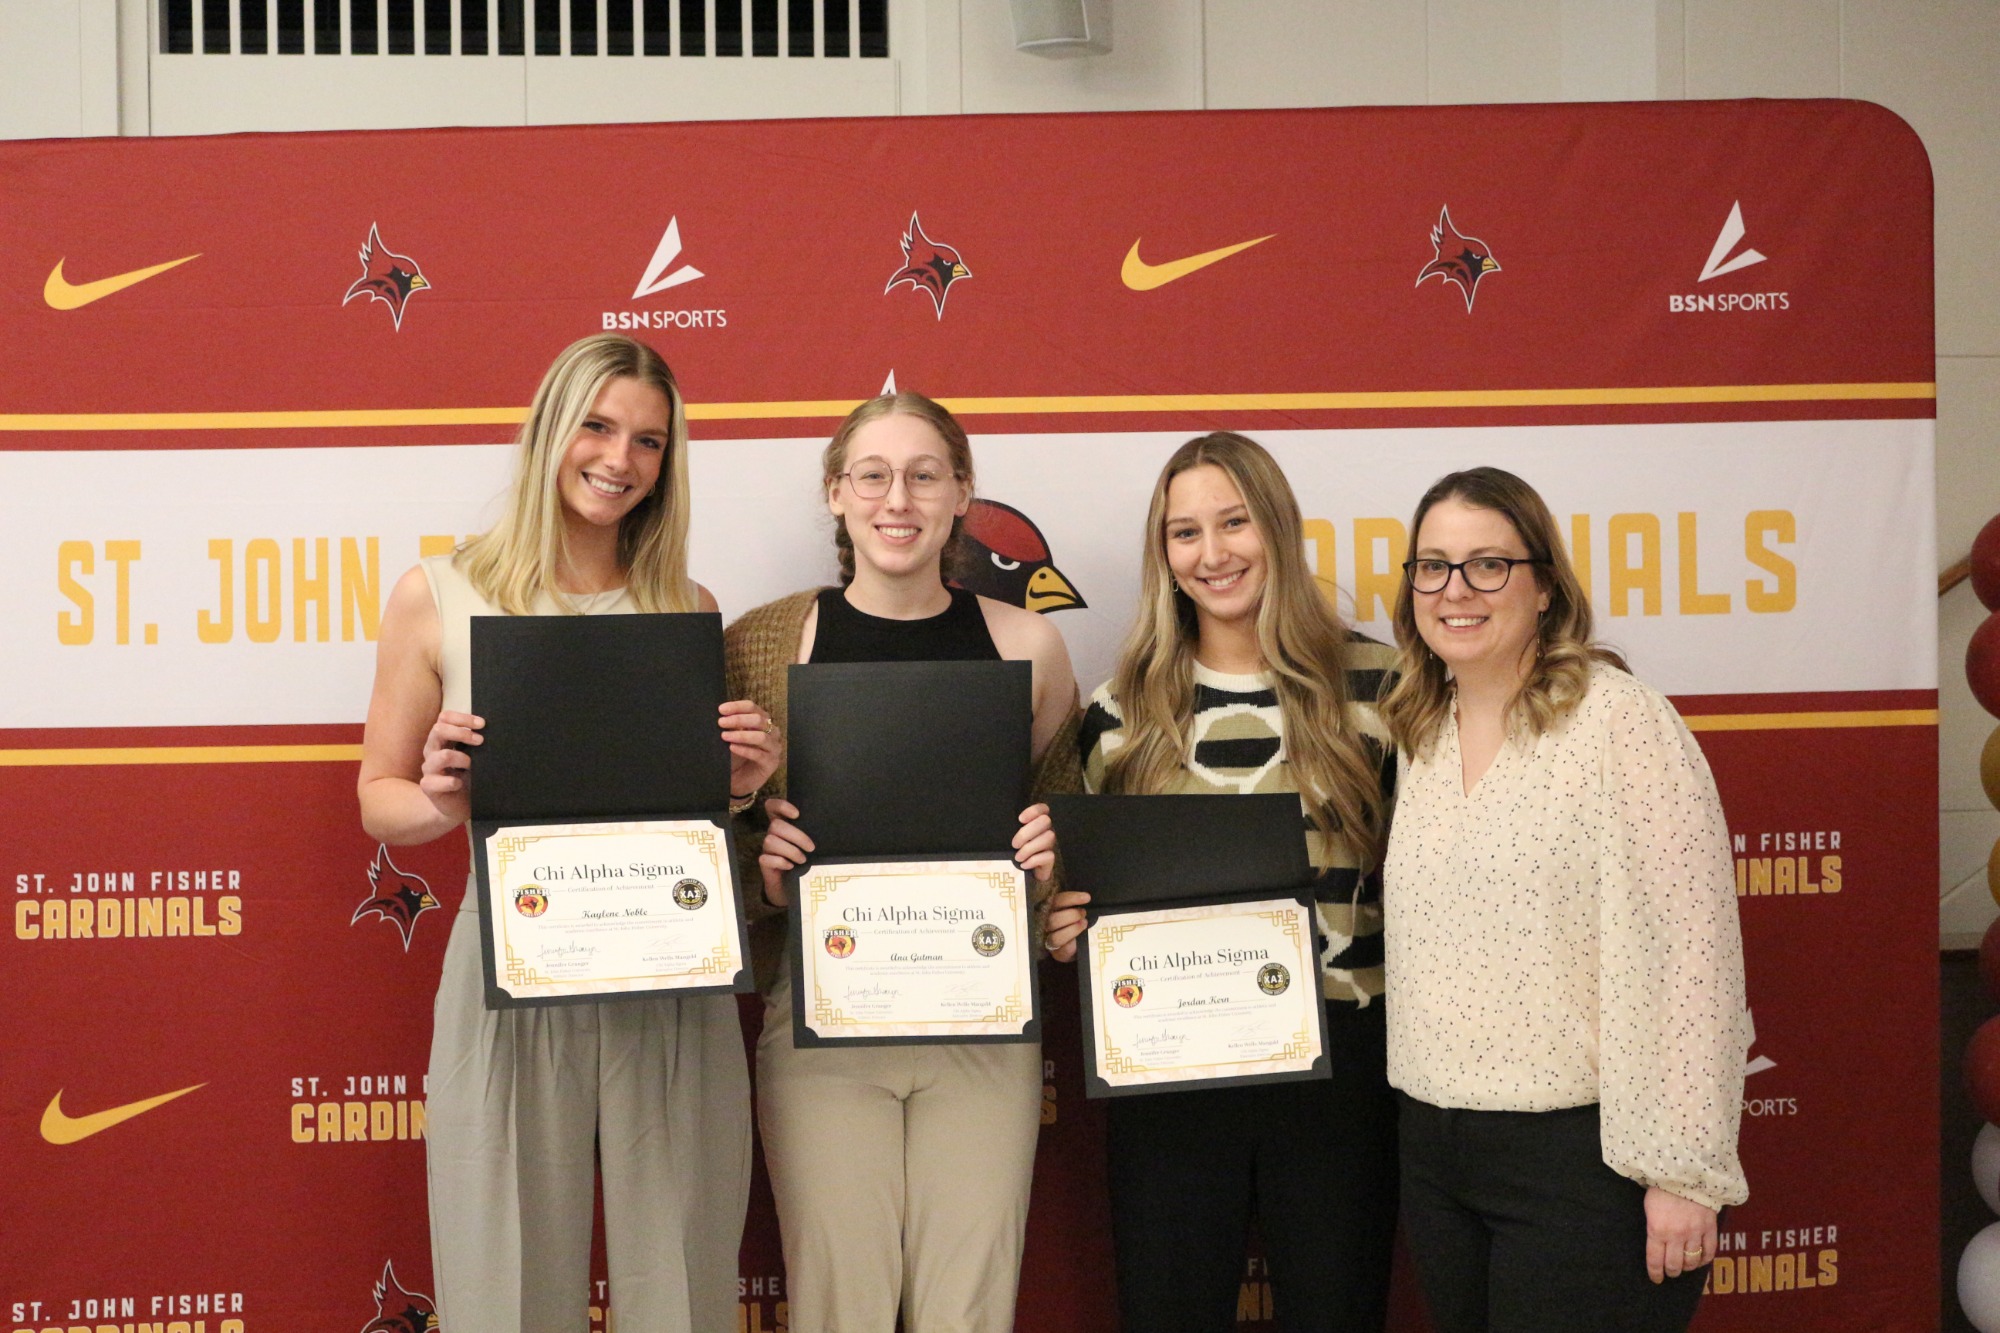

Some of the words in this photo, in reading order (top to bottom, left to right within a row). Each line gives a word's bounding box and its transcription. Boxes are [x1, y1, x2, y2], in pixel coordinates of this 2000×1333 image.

[1669, 294, 1715, 312] BSN
[1718, 292, 1790, 312] SPORTS
[602, 311, 650, 330] BSN
[652, 309, 727, 329] SPORTS
[56, 539, 158, 646] ST.
[197, 536, 380, 644] JOHN
[1760, 831, 1841, 852] FISHER
[16, 874, 54, 893] ST.
[70, 872, 135, 893] JOHN
[150, 870, 241, 891] FISHER
[533, 865, 565, 881] Chi
[570, 863, 624, 882] Alpha
[629, 862, 685, 881] Sigma
[1736, 855, 1842, 896] INALS
[15, 896, 242, 940] CARDINALS
[842, 906, 872, 922] Chi
[877, 905, 928, 925] Alpha
[932, 905, 985, 924] Sigma
[1129, 955, 1158, 971] Chi
[1163, 950, 1212, 971] Alpha
[1217, 948, 1269, 966] Sigma
[291, 1078, 328, 1097] ST.
[344, 1075, 407, 1096] JOHN
[291, 1100, 427, 1143] CARDIN
[1761, 1225, 1838, 1249] FISHER
[1703, 1249, 1839, 1295] DINALS
[12, 1302, 50, 1323] ST.
[68, 1298, 135, 1320] JOHN
[151, 1293, 243, 1316] FISHER
